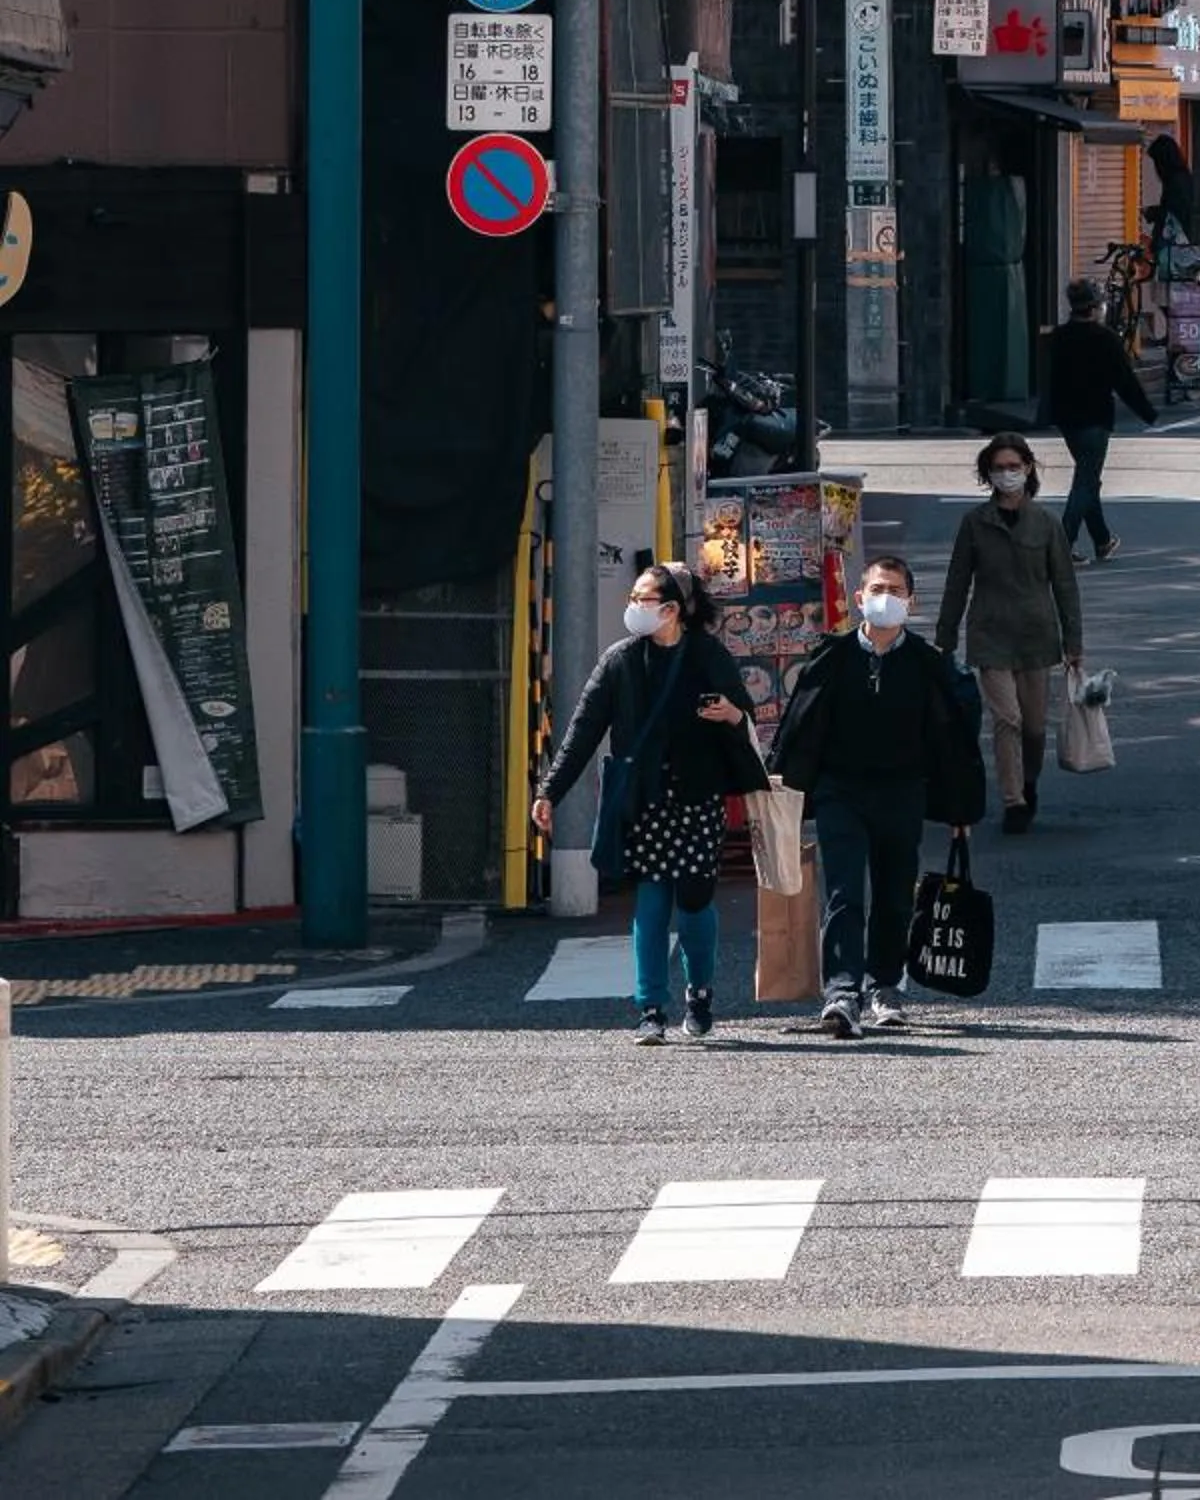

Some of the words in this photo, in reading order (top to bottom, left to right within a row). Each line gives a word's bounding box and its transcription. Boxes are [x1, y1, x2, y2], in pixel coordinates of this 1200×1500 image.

[459, 63, 476, 81] 16
[522, 64, 539, 81] 18
[453, 84, 545, 102] 日曜・休日は
[858, 36, 878, 147] こいぬま歯科
[459, 104, 476, 121] 13
[521, 105, 538, 122] 18
